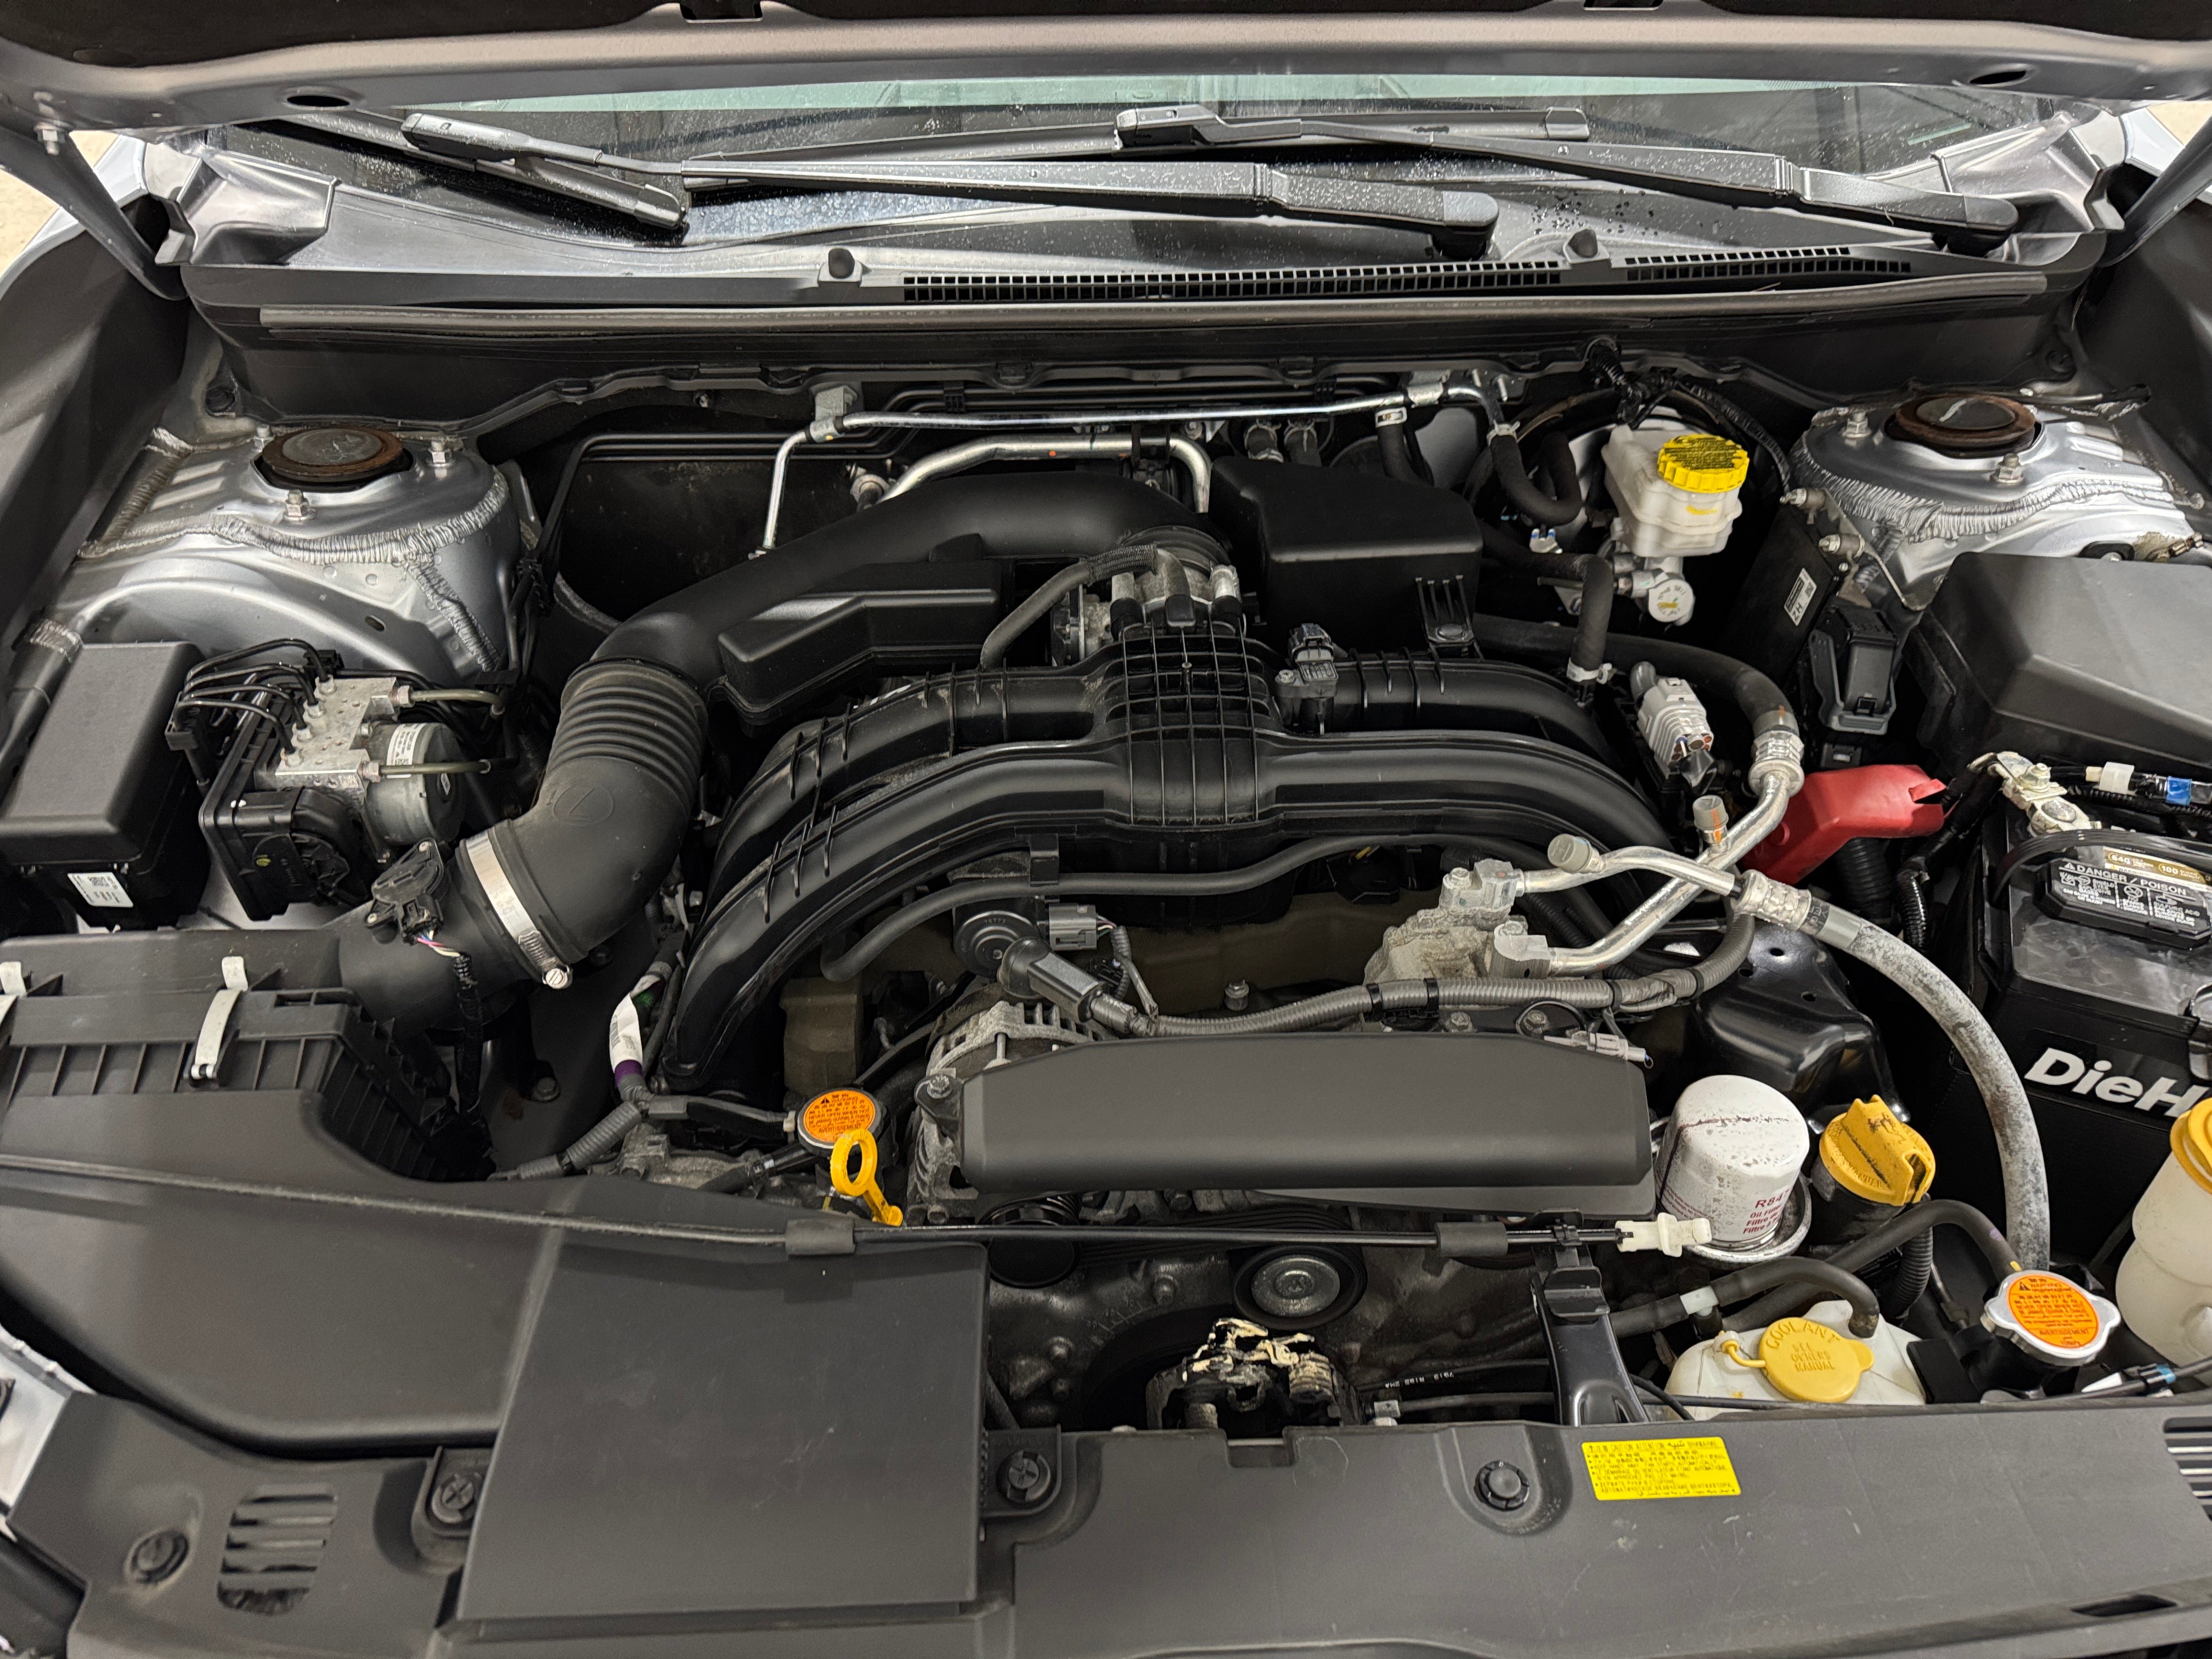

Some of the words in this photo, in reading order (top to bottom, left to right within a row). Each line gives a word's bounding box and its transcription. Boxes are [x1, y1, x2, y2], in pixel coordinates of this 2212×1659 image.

[2076, 864, 2128, 883] DANGER
[2140, 879, 2187, 896] POISON
[2161, 865, 2179, 875] 100
[1765, 1321, 1841, 1350] COOLANT
